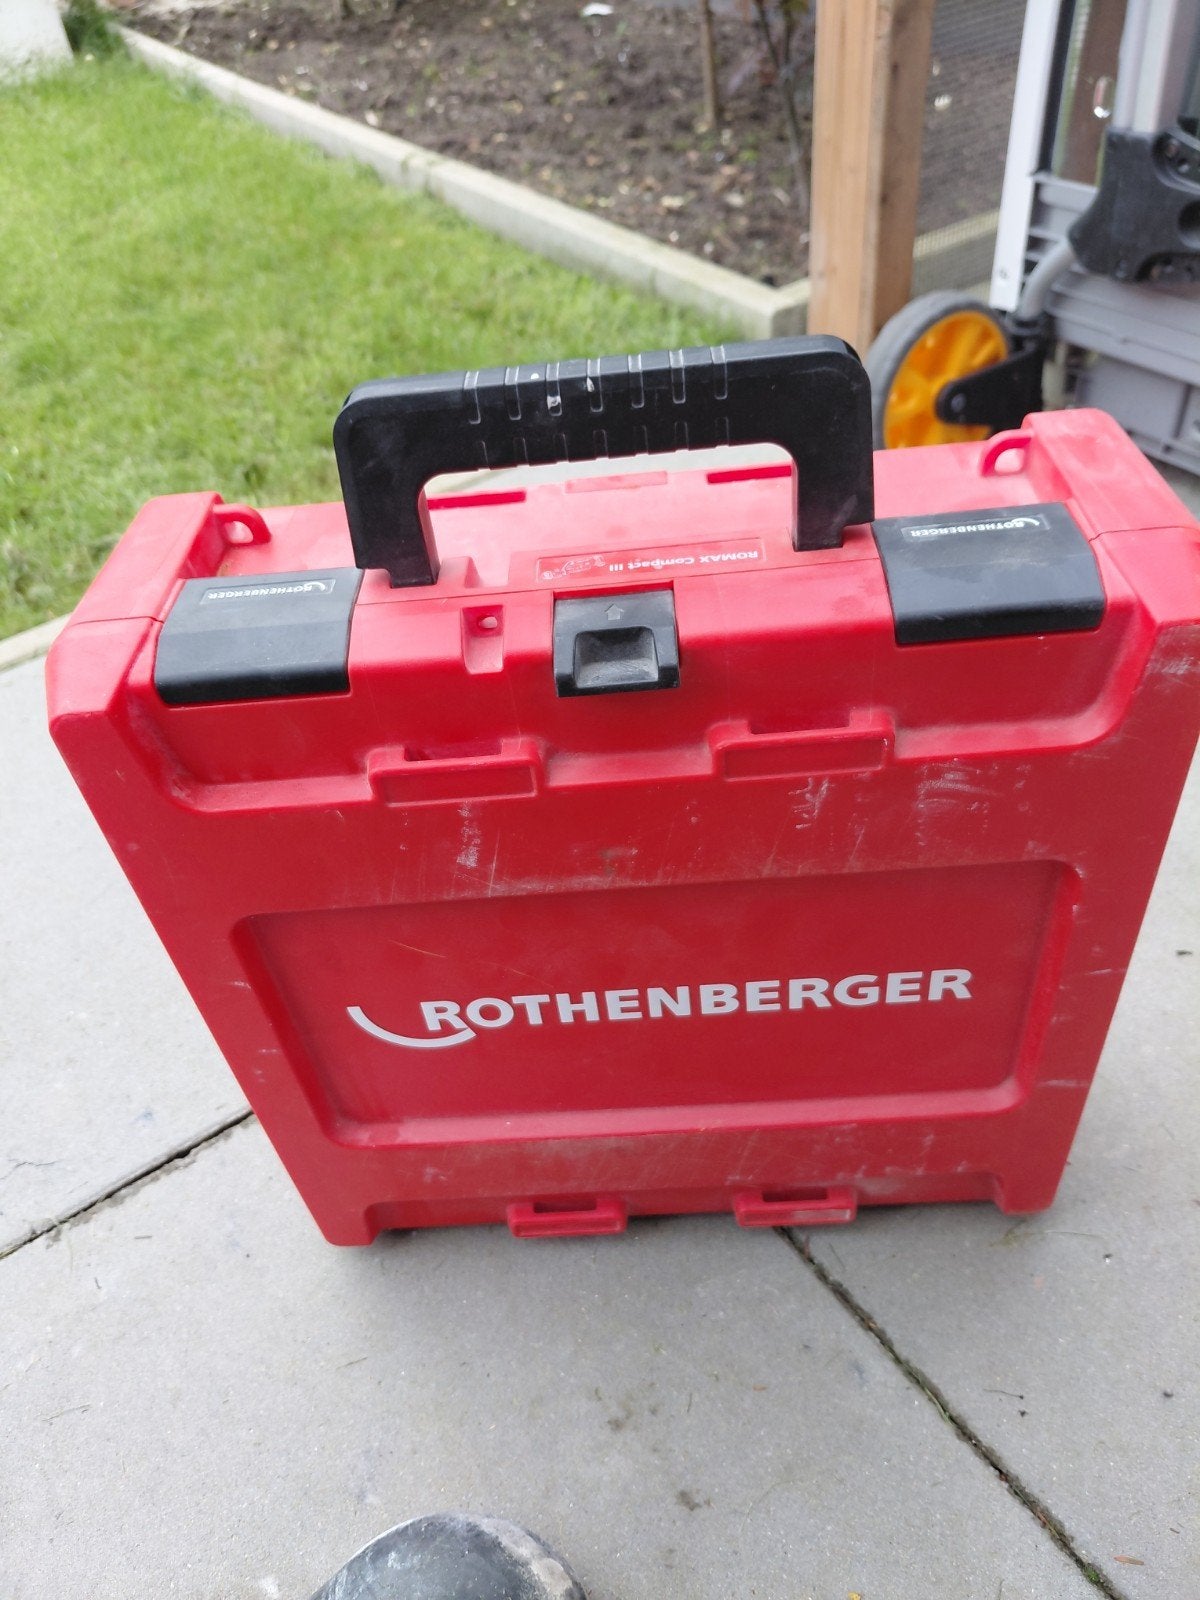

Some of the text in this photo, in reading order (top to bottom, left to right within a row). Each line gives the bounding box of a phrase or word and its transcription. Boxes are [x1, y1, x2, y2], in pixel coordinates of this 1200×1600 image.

[910, 521, 1025, 537] ROTHENBERGER
[627, 556, 696, 570] Compact
[699, 550, 759, 564] ROMAX
[208, 585, 313, 600] ROTHENBERGER
[420, 968, 972, 1031] ROTHENBERGER
